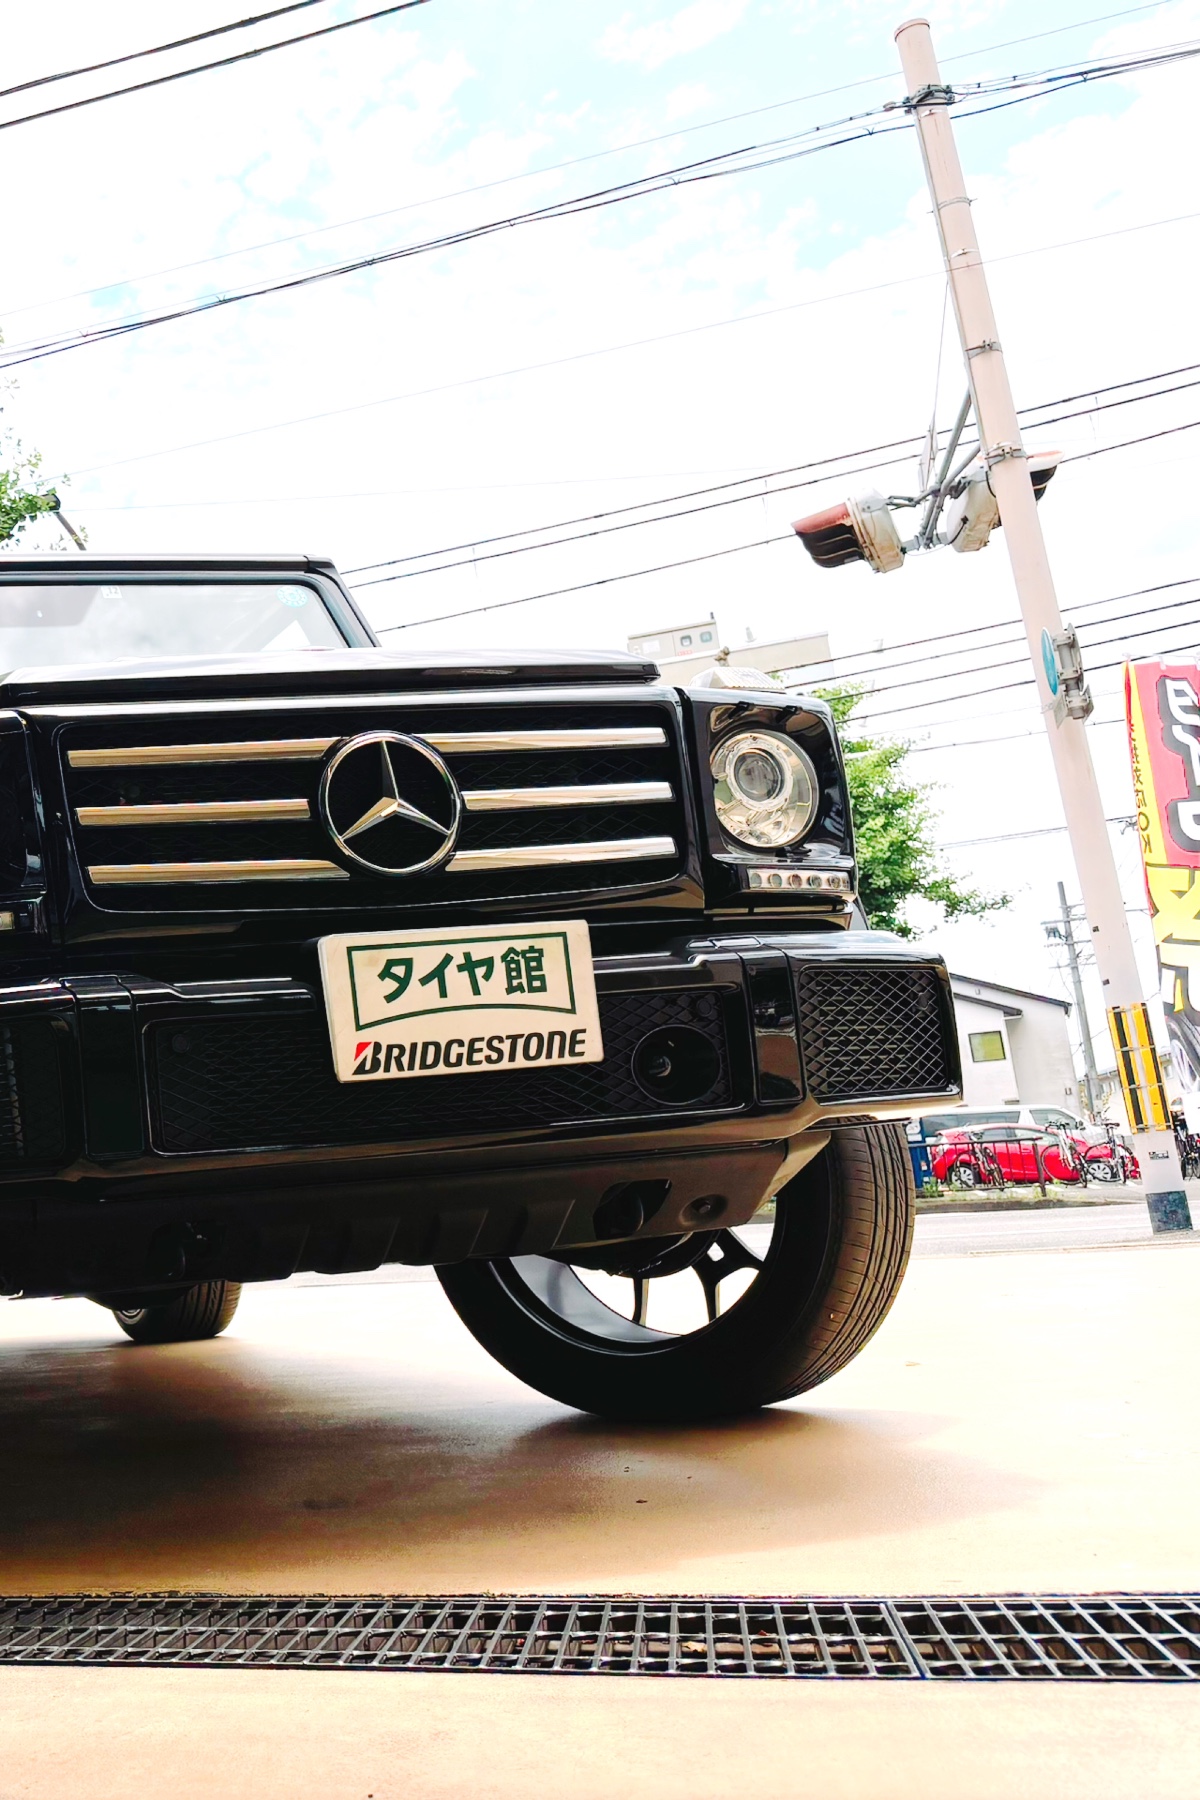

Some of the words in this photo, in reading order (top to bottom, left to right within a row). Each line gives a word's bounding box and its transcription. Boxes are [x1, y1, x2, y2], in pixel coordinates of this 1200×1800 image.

[377, 945, 548, 1004] タイヤ館
[351, 1028, 587, 1075] BRIDGESTONE
